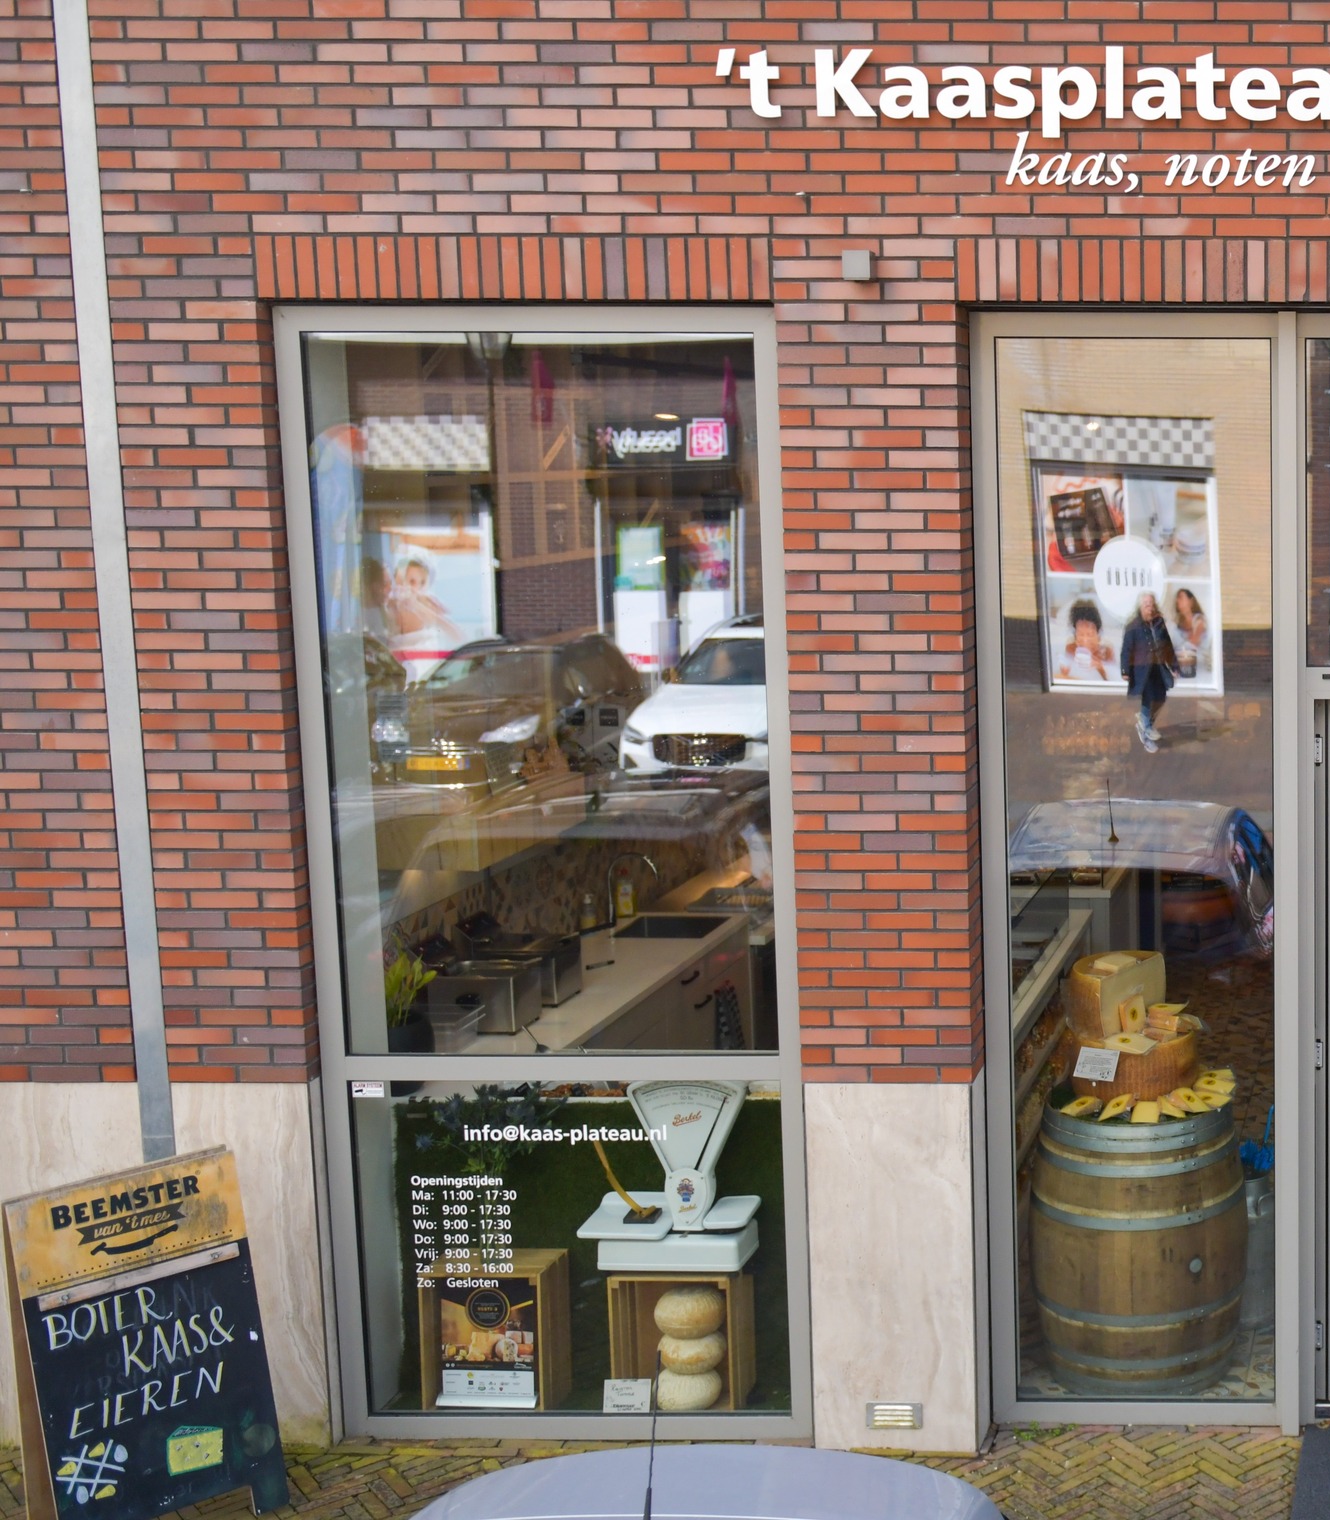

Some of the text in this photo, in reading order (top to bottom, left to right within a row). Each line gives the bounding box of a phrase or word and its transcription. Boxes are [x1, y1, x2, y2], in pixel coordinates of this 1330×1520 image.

[1005, 124, 1139, 193] kaas,
[1165, 148, 1317, 188] noten
[463, 1124, 668, 1146] info@kaas-plateau.nl
[410, 1175, 503, 1188] Openingstijden
[412, 1190, 435, 1200] Ma:
[442, 1190, 474, 1200] 11:00
[50, 1174, 200, 1230] BEEMSTER
[412, 1205, 429, 1215] Di:
[442, 1205, 468, 1215] 9:00
[479, 1205, 511, 1215] 17:30
[93, 1219, 123, 1239] van
[139, 1210, 171, 1228] mes
[413, 1219, 437, 1230] Wo:
[443, 1219, 468, 1230] 9:00
[480, 1219, 511, 1230] 17:30
[414, 1234, 435, 1244] Do:
[444, 1234, 469, 1244] 9:00
[481, 1234, 512, 1244] 17:30
[415, 1248, 439, 1261] Vrij:
[444, 1248, 470, 1259] 9:00
[481, 1248, 513, 1259] 17:30
[416, 1263, 434, 1273] Za:
[445, 1263, 471, 1273] 8:30
[482, 1263, 514, 1273] 16:00
[416, 1277, 499, 1288] Zo: Gesloten
[42, 1286, 174, 1350] BOTER,
